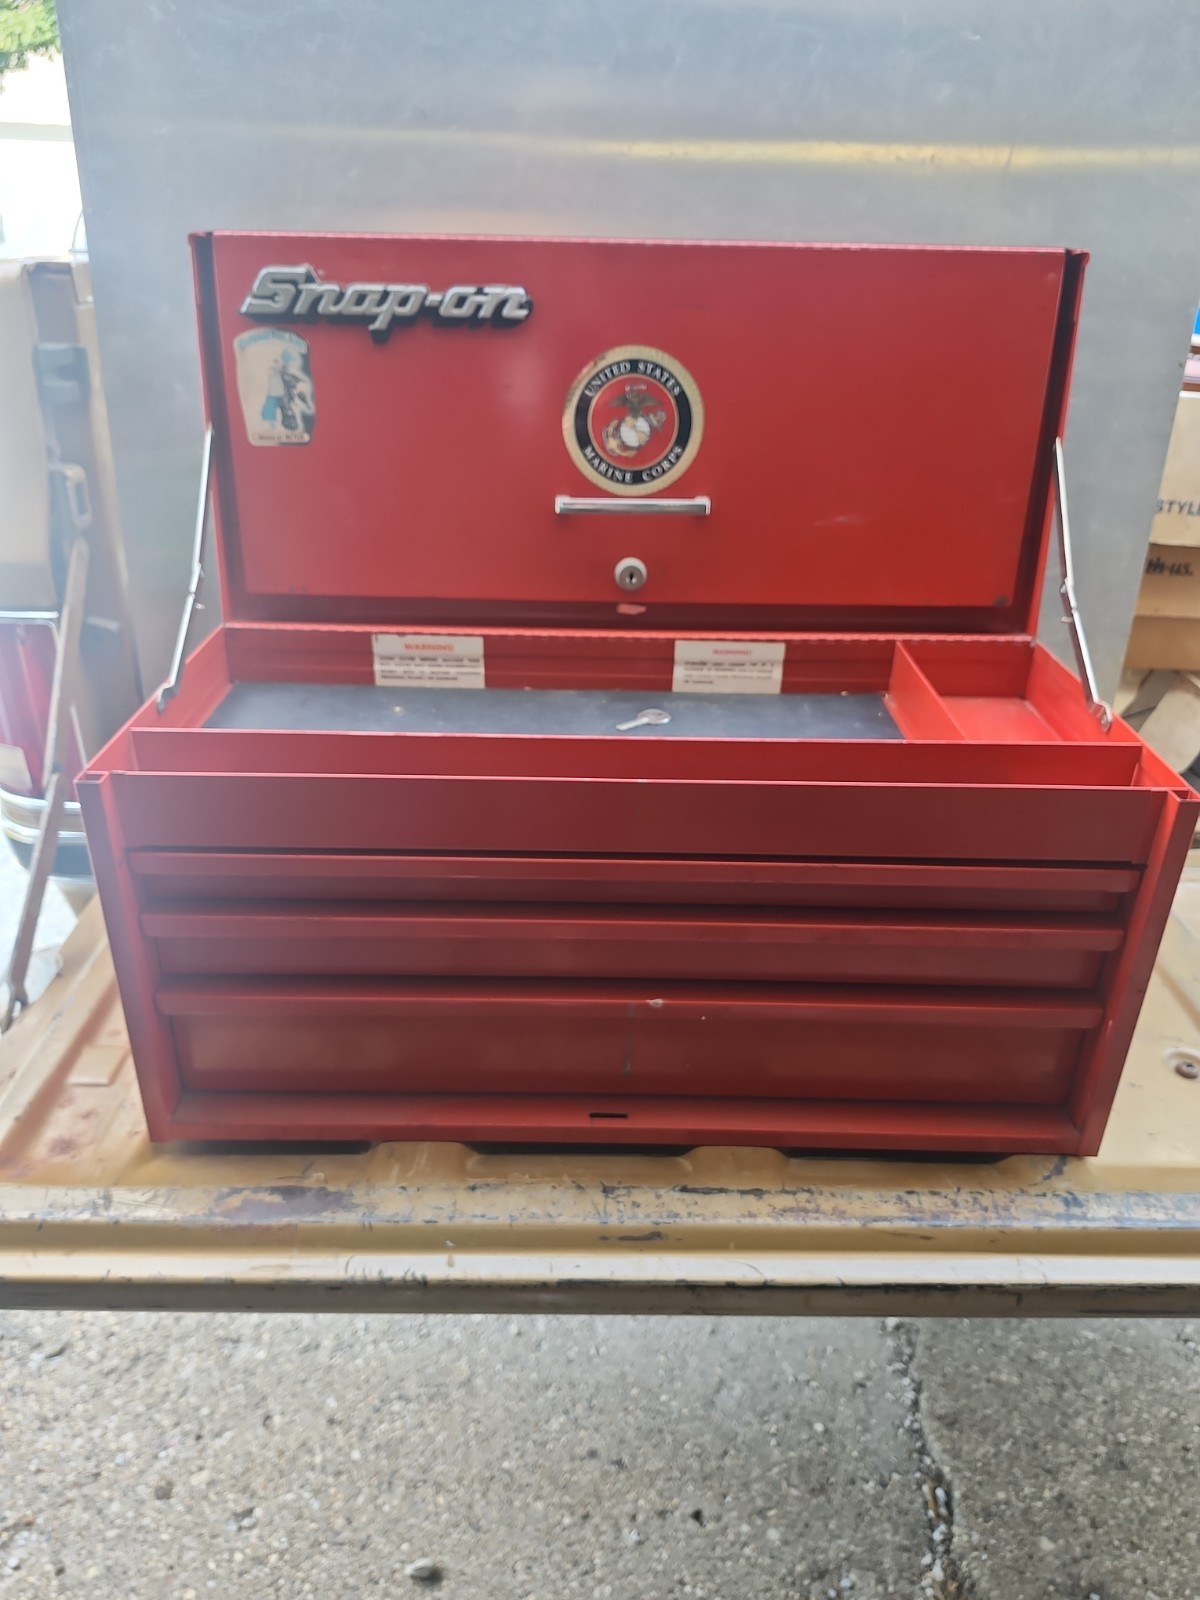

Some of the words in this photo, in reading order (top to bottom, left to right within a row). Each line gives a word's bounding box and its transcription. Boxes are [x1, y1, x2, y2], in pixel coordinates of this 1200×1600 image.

[239, 264, 532, 341] Snap-on
[584, 361, 631, 397] UNITED
[638, 361, 681, 396] STATES
[584, 445, 634, 484] MARINE
[642, 445, 682, 482] CORPS
[1156, 499, 1200, 515] STYL
